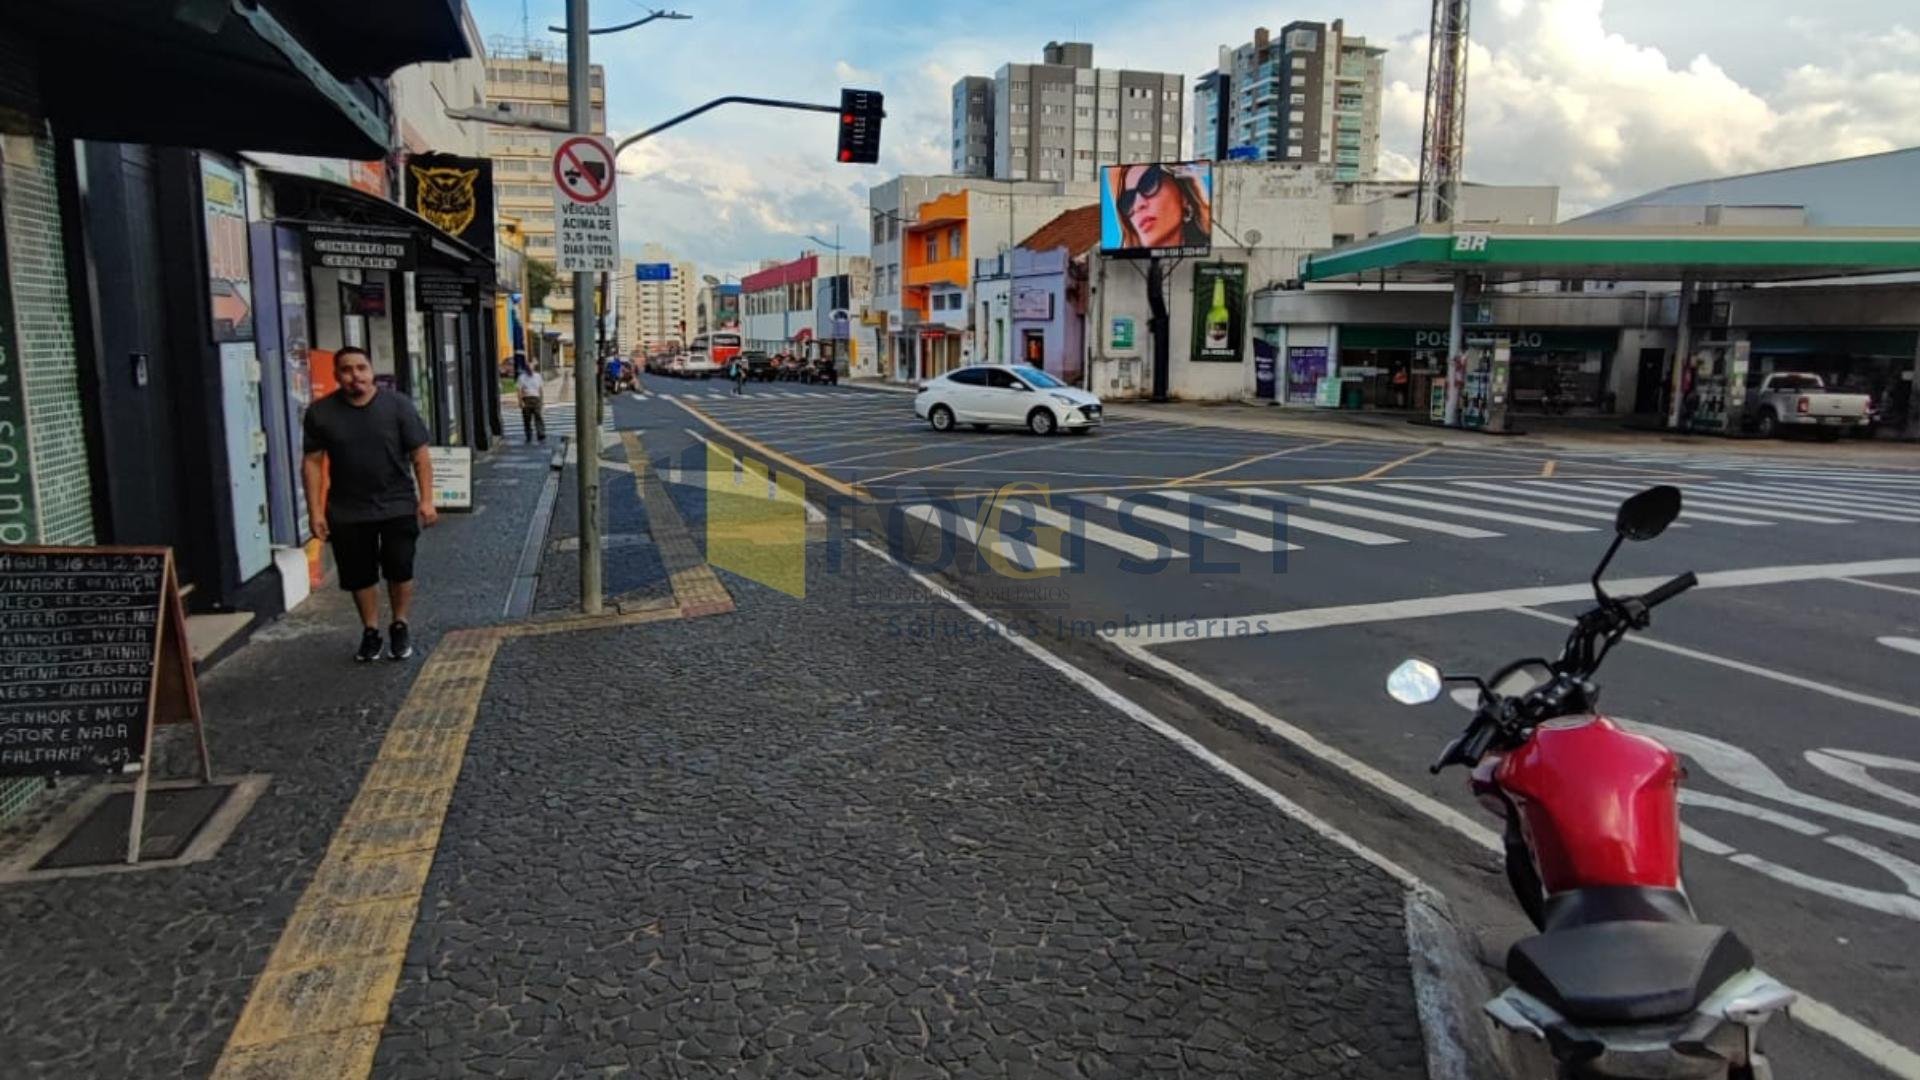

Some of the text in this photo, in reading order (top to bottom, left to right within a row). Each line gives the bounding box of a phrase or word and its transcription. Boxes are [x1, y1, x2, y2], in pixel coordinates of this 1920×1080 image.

[563, 218, 612, 230] ACIMA DE
[563, 244, 585, 255] DIAS
[1454, 234, 1489, 251] BR
[94, 704, 139, 721] MEU
[76, 722, 129, 740] NADA
